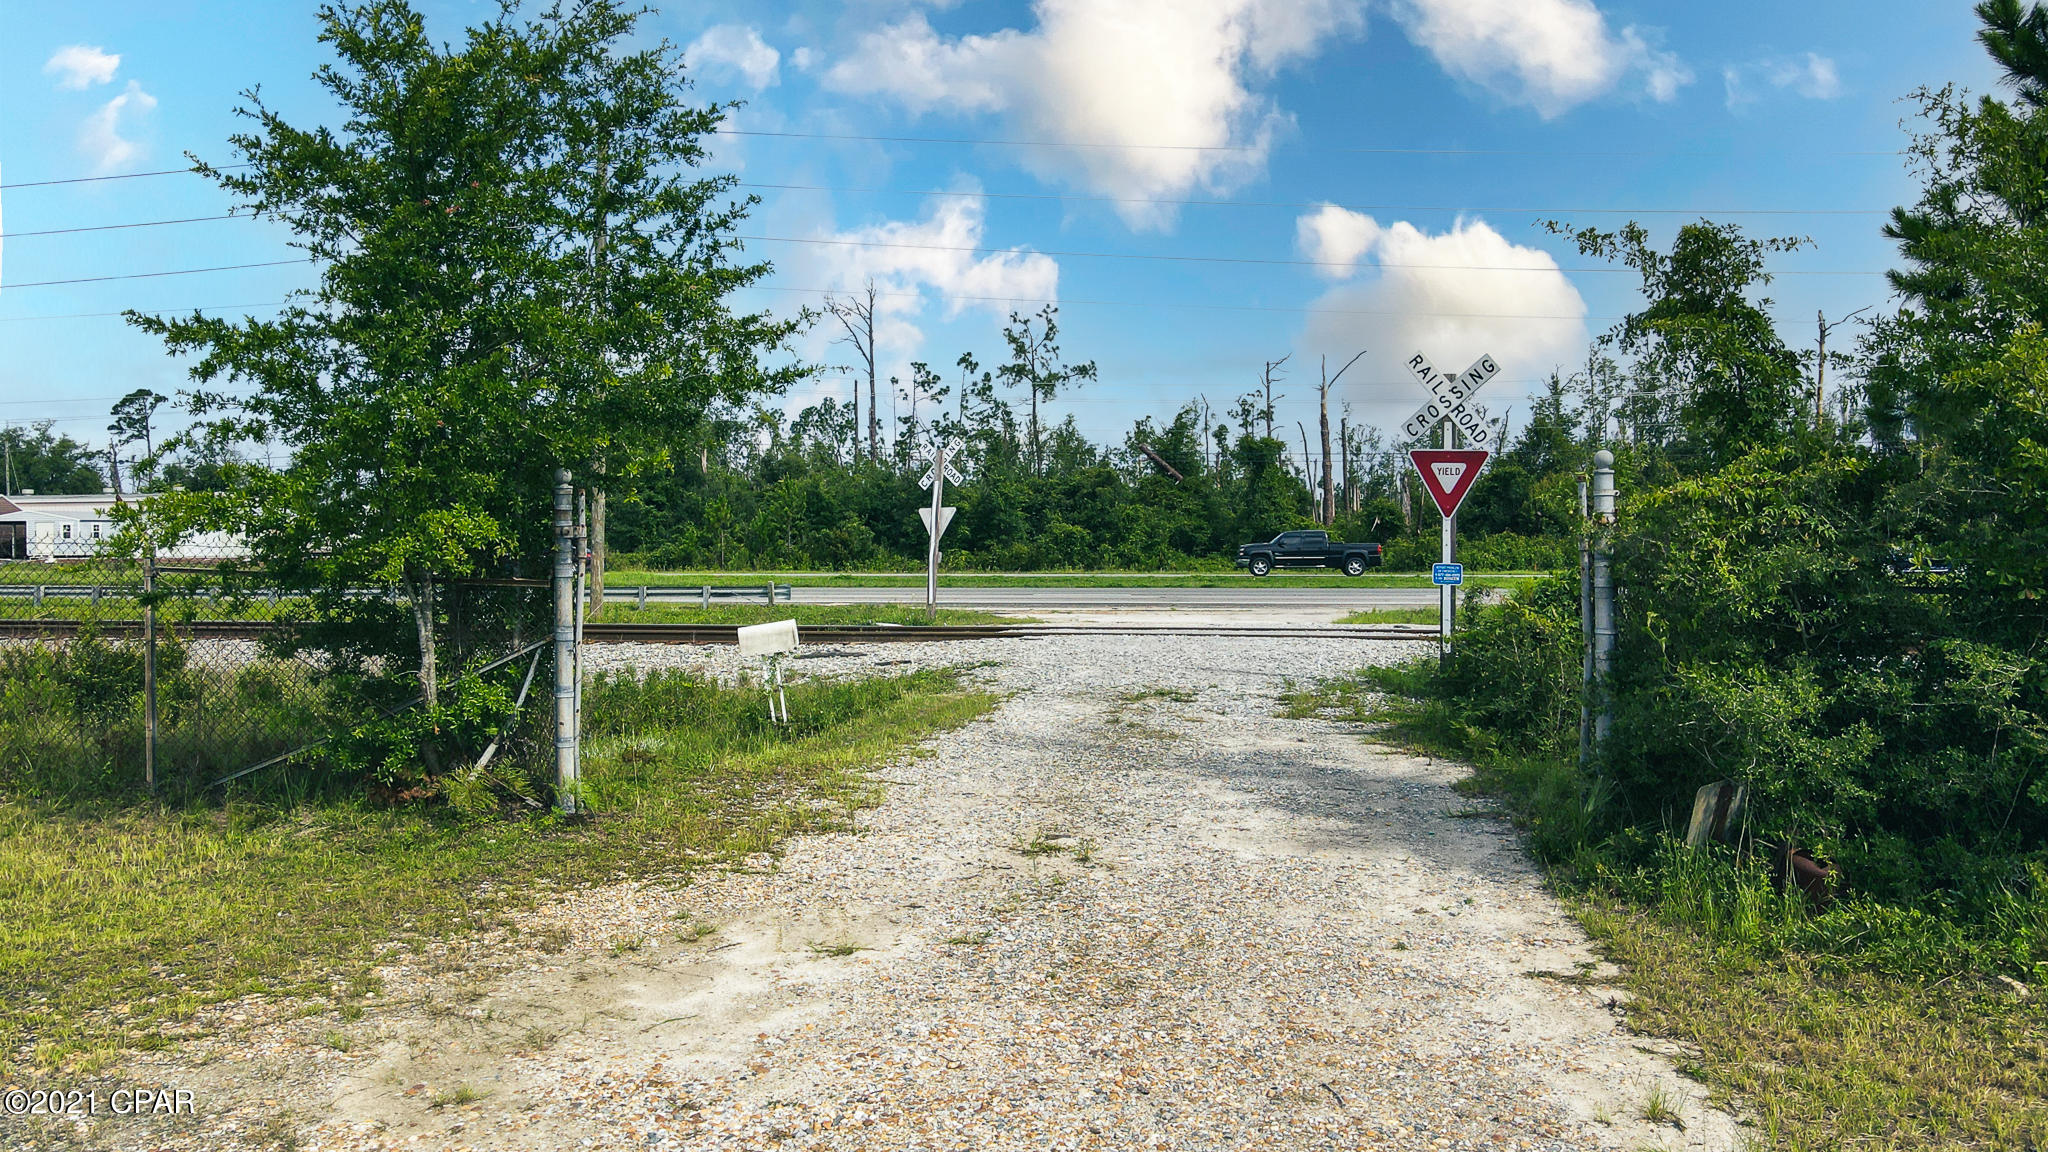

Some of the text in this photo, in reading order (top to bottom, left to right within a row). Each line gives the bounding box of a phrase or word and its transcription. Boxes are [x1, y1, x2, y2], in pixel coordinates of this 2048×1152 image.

[1406, 359, 1495, 437] CROSSING
[1409, 354, 1487, 443] RAILROAD
[1437, 467, 1461, 476] YIELD
